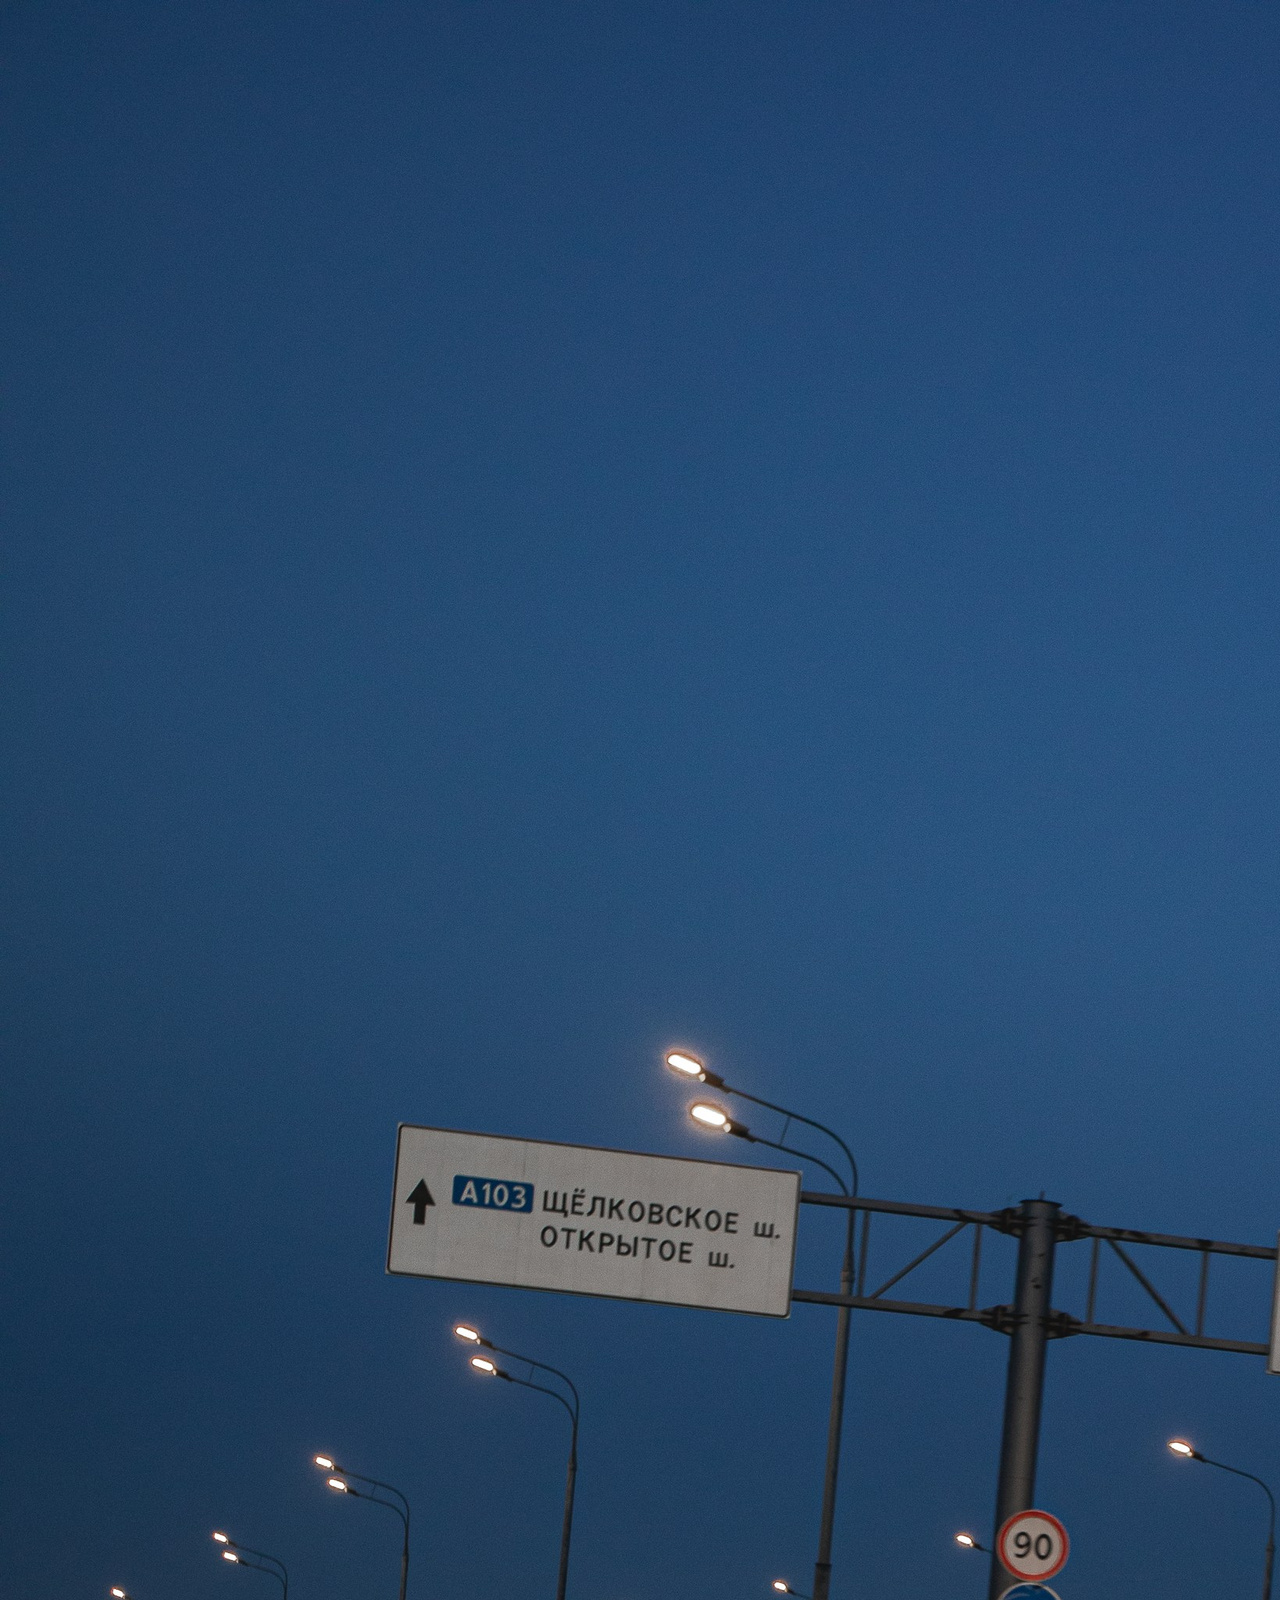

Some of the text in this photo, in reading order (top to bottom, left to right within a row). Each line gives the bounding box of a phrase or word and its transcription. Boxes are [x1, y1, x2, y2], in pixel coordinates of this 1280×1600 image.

[459, 1180, 527, 1209] А103
[542, 1187, 740, 1234] ЩЁЛКОВСКОЕ
[540, 1225, 694, 1264] ОТКРЫТОЕ
[1014, 1531, 1053, 1560] 90
